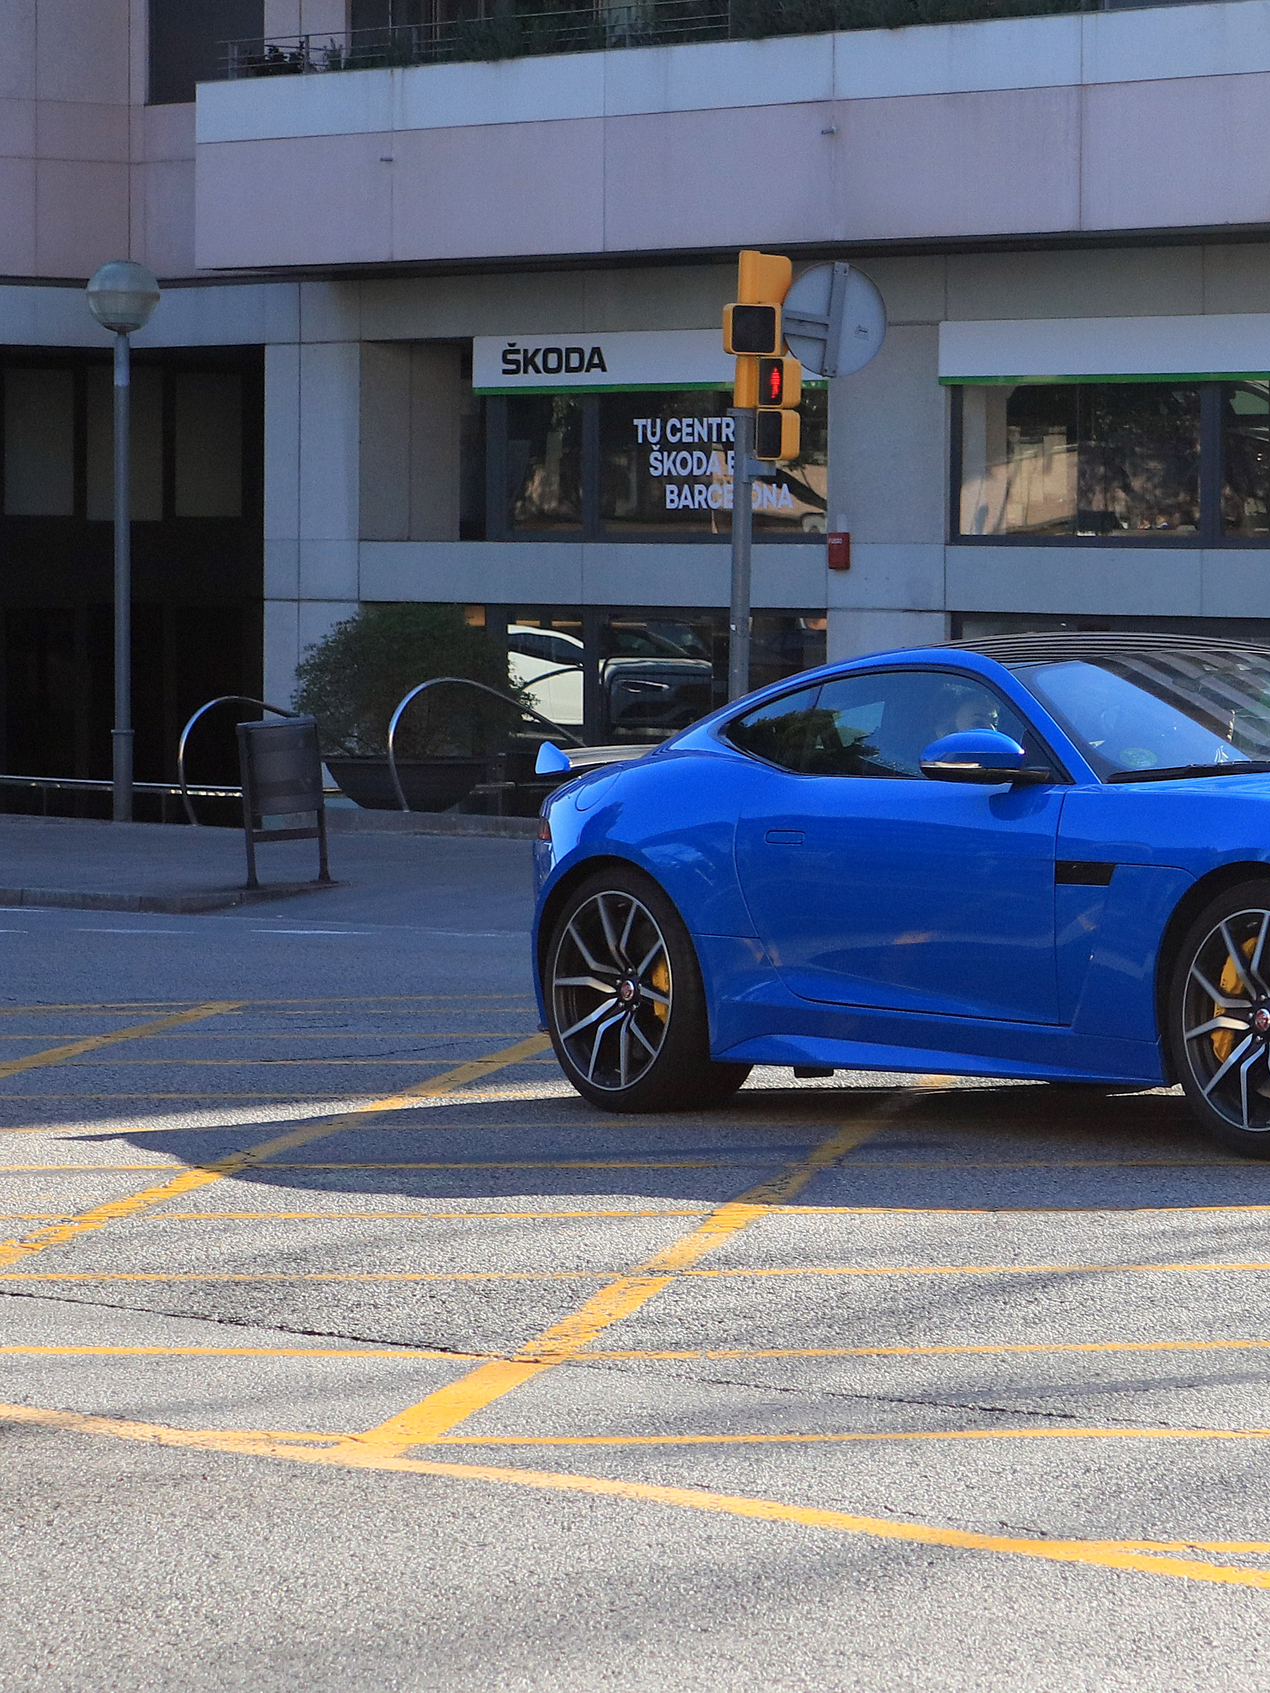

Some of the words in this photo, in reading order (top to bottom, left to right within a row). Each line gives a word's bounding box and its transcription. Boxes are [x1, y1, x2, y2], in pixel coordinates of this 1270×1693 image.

[502, 343, 607, 375] ŠKODA
[633, 418, 661, 444] TU
[665, 417, 736, 444] CENTR
[649, 444, 723, 477] ŠKODA
[665, 483, 794, 510] BARCEONA
